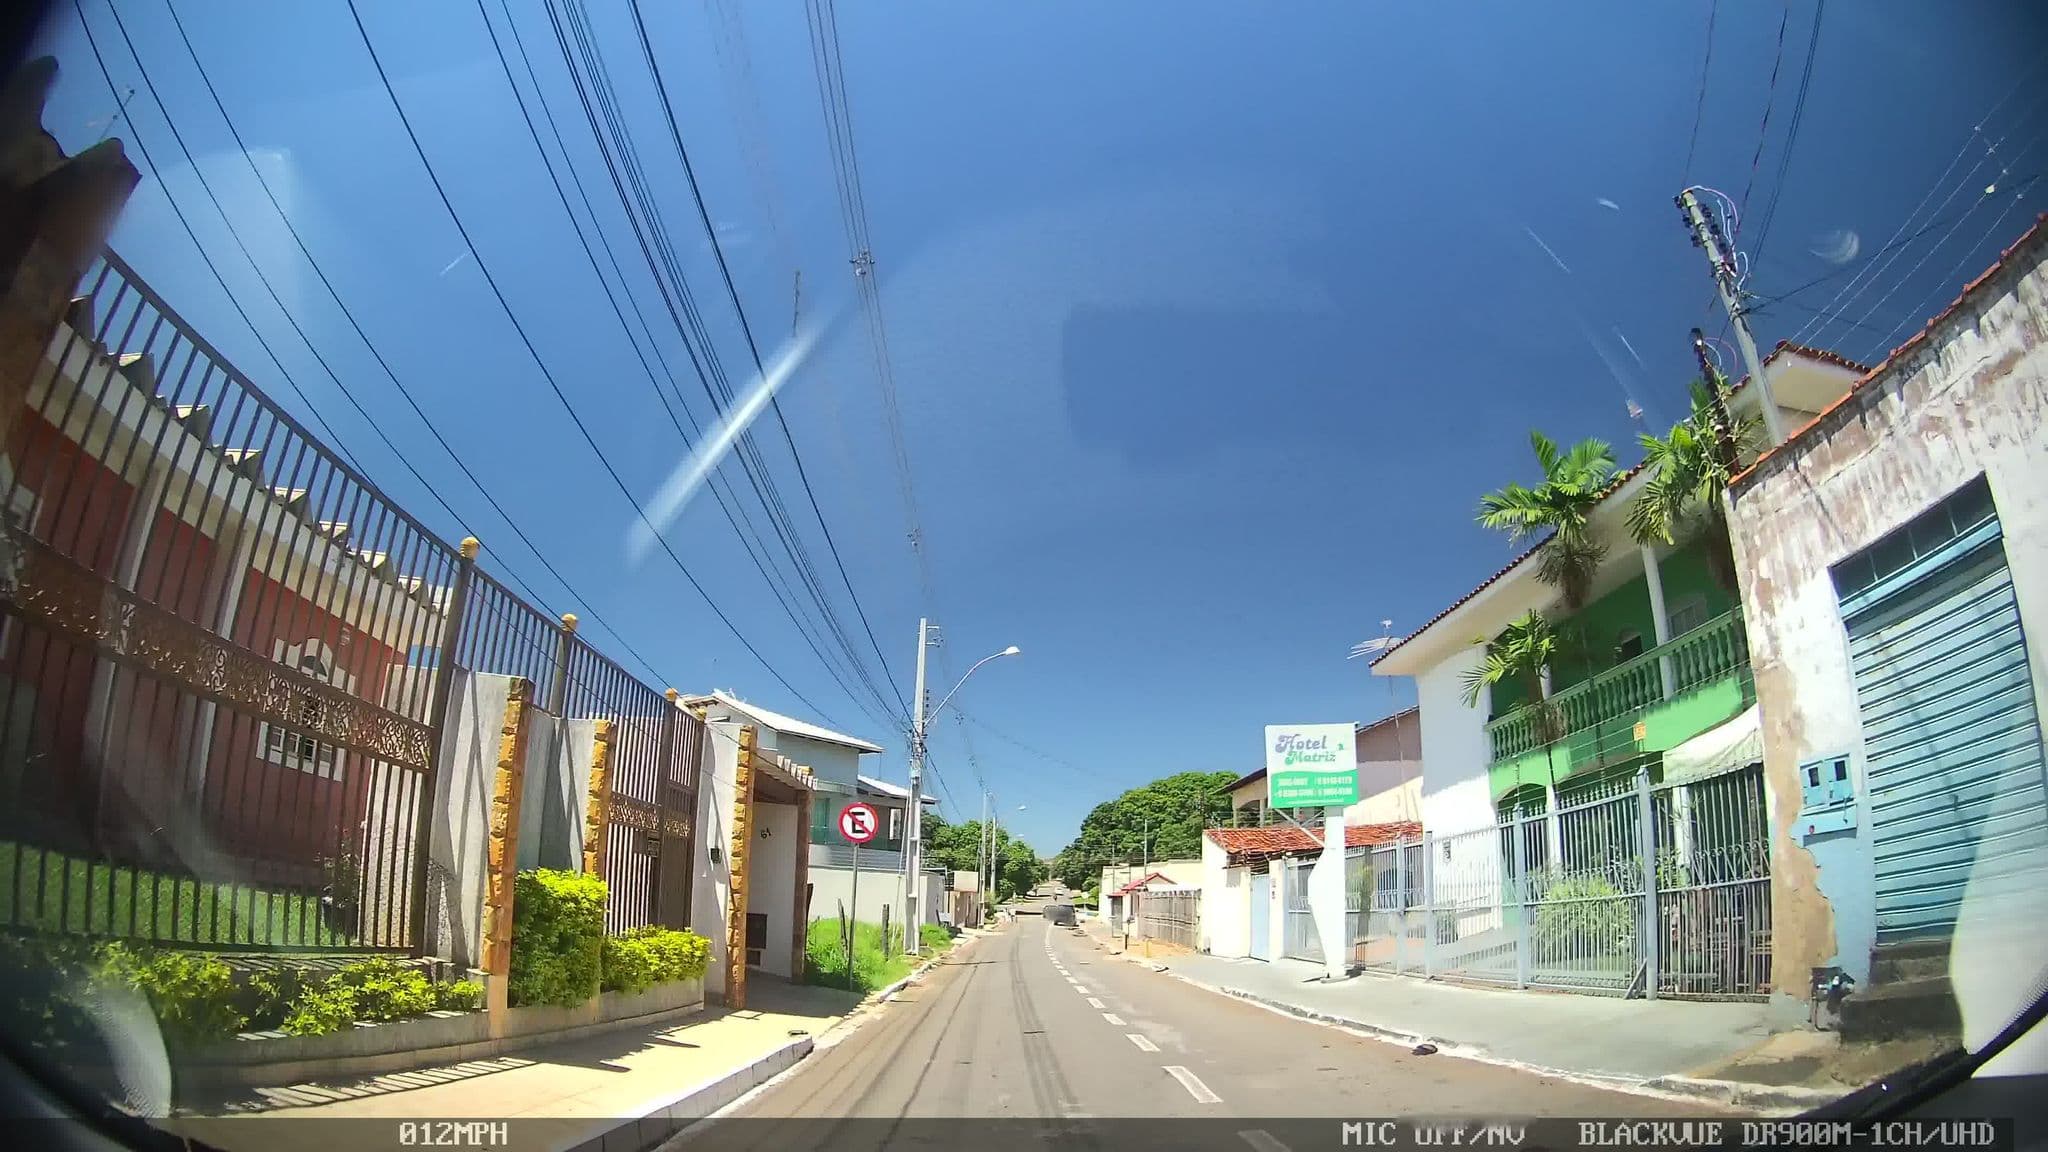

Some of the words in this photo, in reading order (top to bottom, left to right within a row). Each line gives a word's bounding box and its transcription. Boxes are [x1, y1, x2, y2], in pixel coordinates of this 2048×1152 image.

[1275, 734, 1327, 752] Hotel
[1284, 751, 1336, 765] Matriz
[851, 812, 866, 833] E
